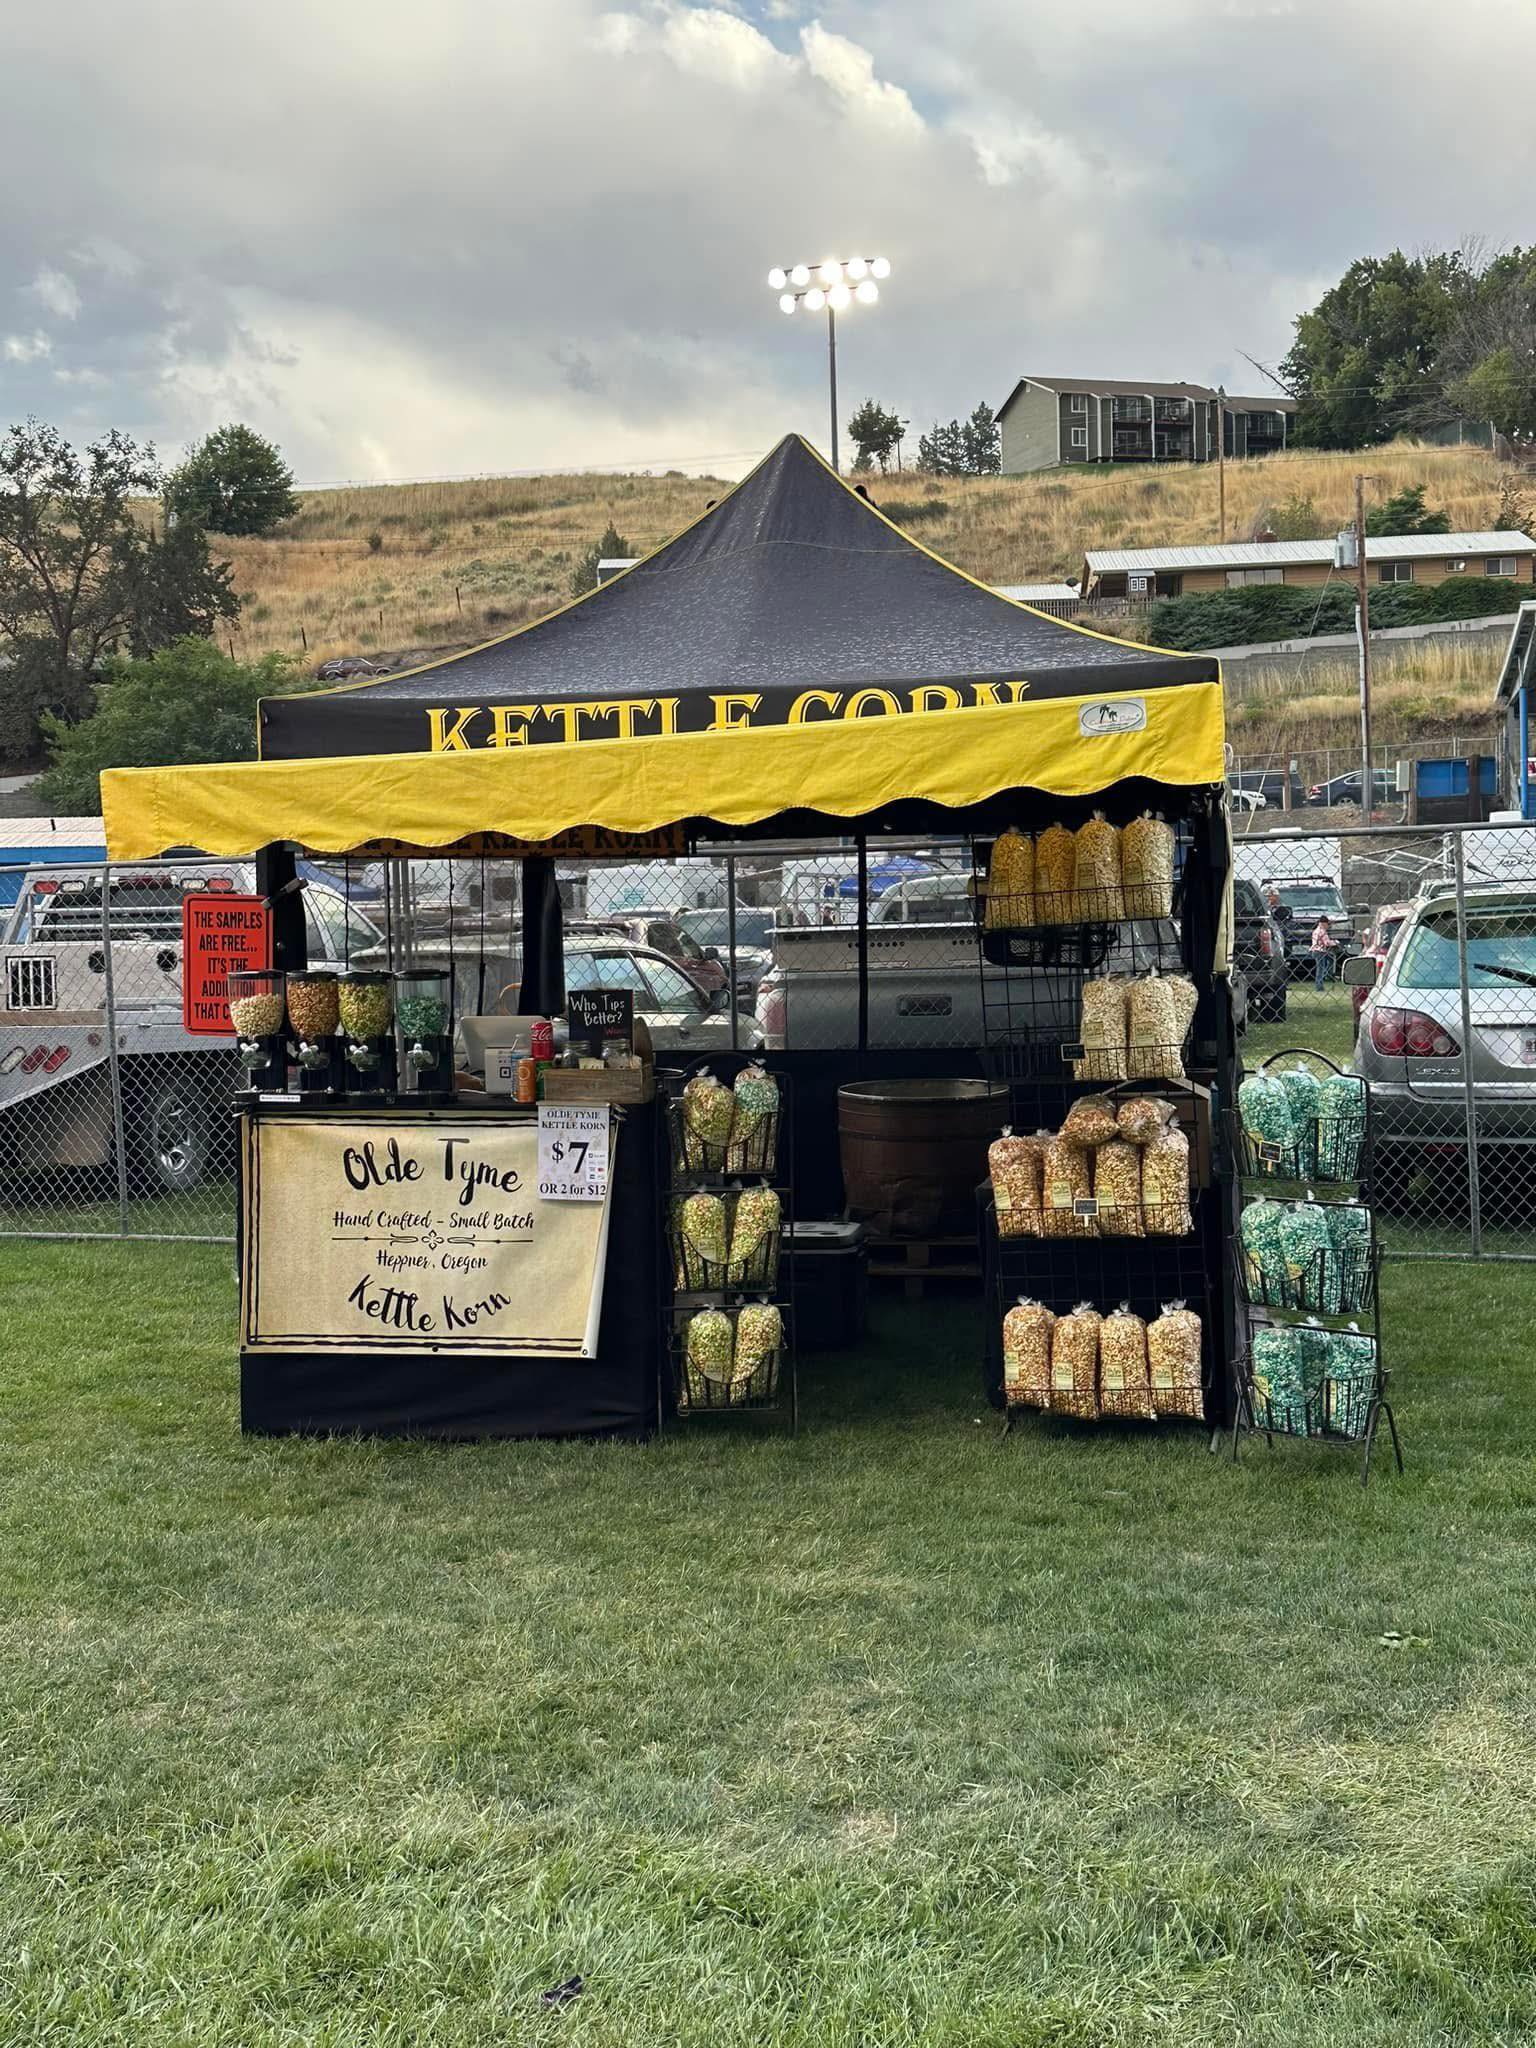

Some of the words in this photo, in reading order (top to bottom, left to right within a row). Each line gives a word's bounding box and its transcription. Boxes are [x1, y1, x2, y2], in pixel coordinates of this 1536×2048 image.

[194, 911, 214, 928] THE
[216, 911, 263, 929] SAMPLES
[199, 935, 219, 951] ARE
[221, 935, 258, 952] FREE...
[207, 957, 227, 974] IT'S
[229, 957, 249, 972] THE
[194, 1002, 220, 1020] THAT
[569, 994, 597, 1012] Who
[599, 993, 625, 1012] Tips
[583, 1012, 623, 1027] Better?
[547, 1110, 572, 1119] OLDE
[574, 1111, 600, 1119] TYME
[541, 1120, 578, 1130] KETTLE
[580, 1121, 606, 1130] KORN
[551, 1140, 590, 1174] $7
[343, 1137, 424, 1191] Olde
[438, 1138, 524, 1206] Tyme
[540, 1183, 558, 1194] OR
[560, 1184, 568, 1194] 2
[569, 1183, 586, 1195] for
[587, 1184, 607, 1196] $12
[332, 1210, 373, 1228] Hand
[377, 1210, 431, 1230] Crafted
[449, 1211, 490, 1229] Small
[493, 1212, 534, 1230] Batch
[441, 1252, 488, 1274] Oregon
[348, 1274, 436, 1332] Kettle
[443, 1289, 512, 1331] Korn
